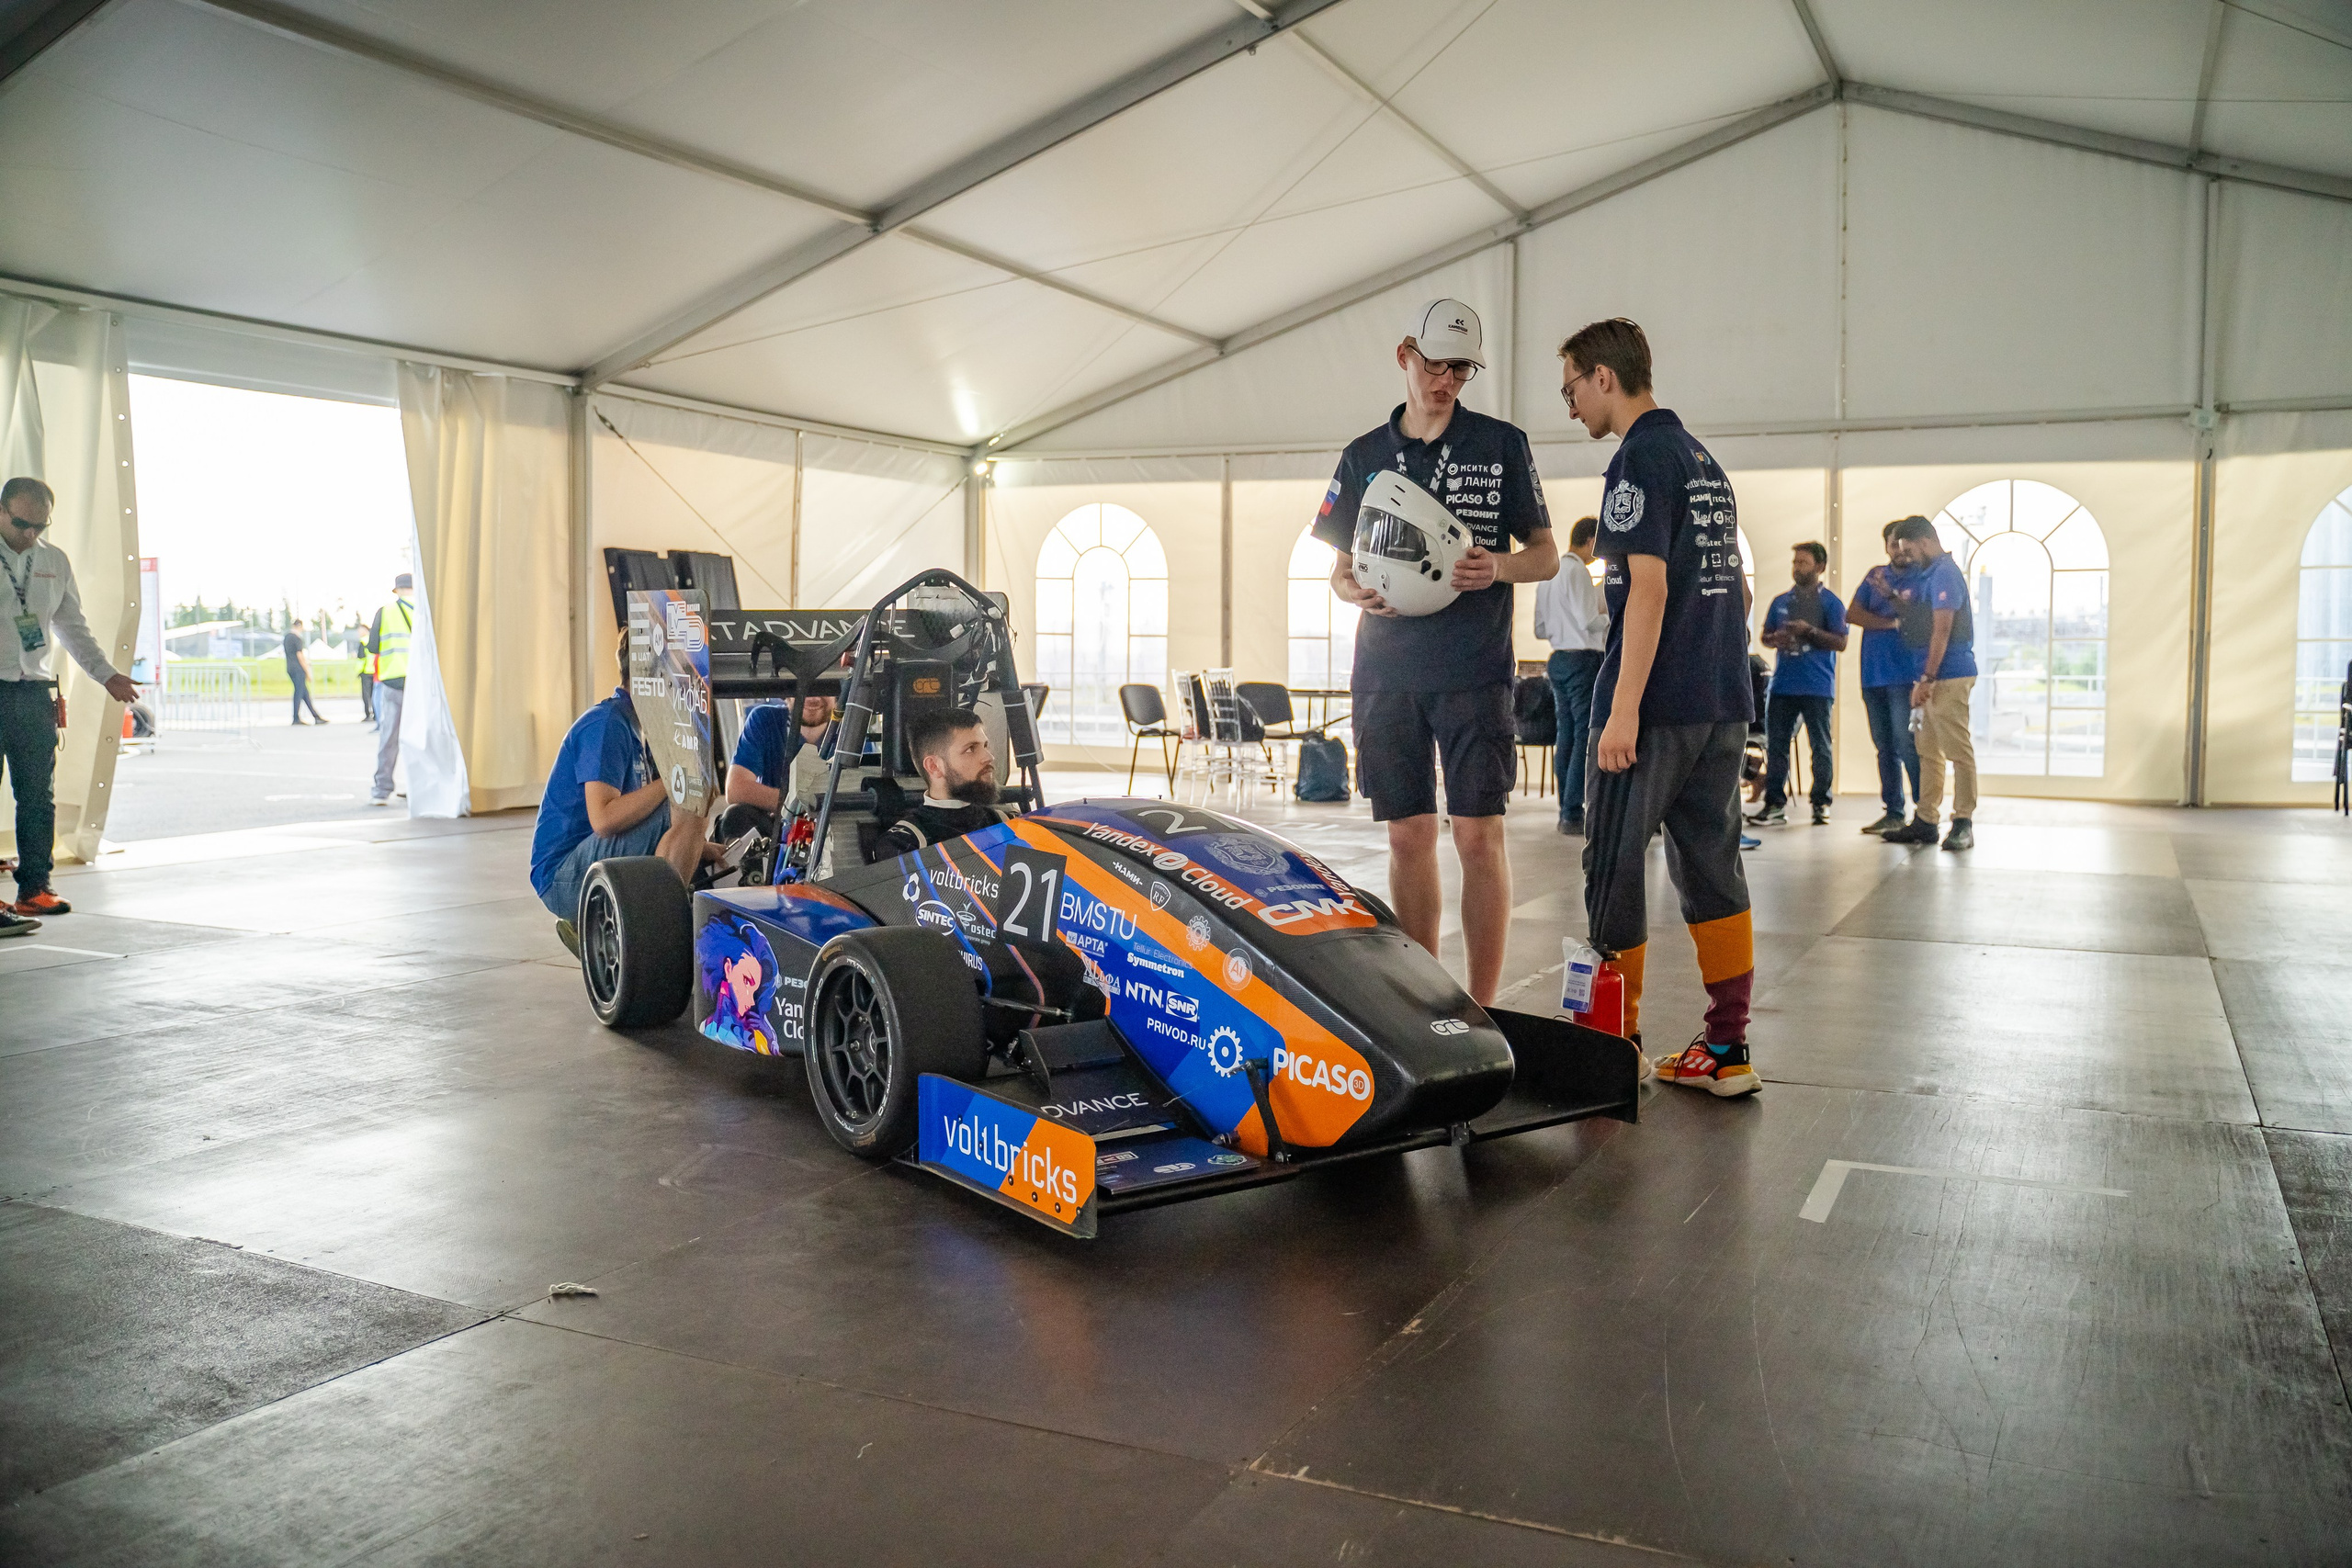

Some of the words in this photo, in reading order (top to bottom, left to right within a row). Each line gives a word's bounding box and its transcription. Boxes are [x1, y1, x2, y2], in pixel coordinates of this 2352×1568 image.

[1460, 464, 1488, 473] МСИТК
[1464, 476, 1502, 489] ЛАНИТ
[1446, 493, 1483, 505] PICASO
[1455, 508, 1499, 520] РЕЗОНИТ
[1475, 536, 1497, 547] Cloud
[631, 676, 666, 698] FESTO
[1083, 821, 1162, 856] Yandex
[1181, 867, 1254, 910] Cloud
[929, 866, 1000, 899] voltbricks
[1002, 862, 1058, 942] 21
[917, 908, 954, 929] SINTEC
[1059, 891, 1137, 941] BMSTU
[970, 924, 996, 939] ostec
[1126, 952, 1185, 979] Symmetron
[1125, 978, 1163, 1009] NTN
[1168, 998, 1196, 1016] SNR
[1146, 1017, 1206, 1051] PRIVOD.RU
[944, 1114, 1077, 1204] voltbricks
